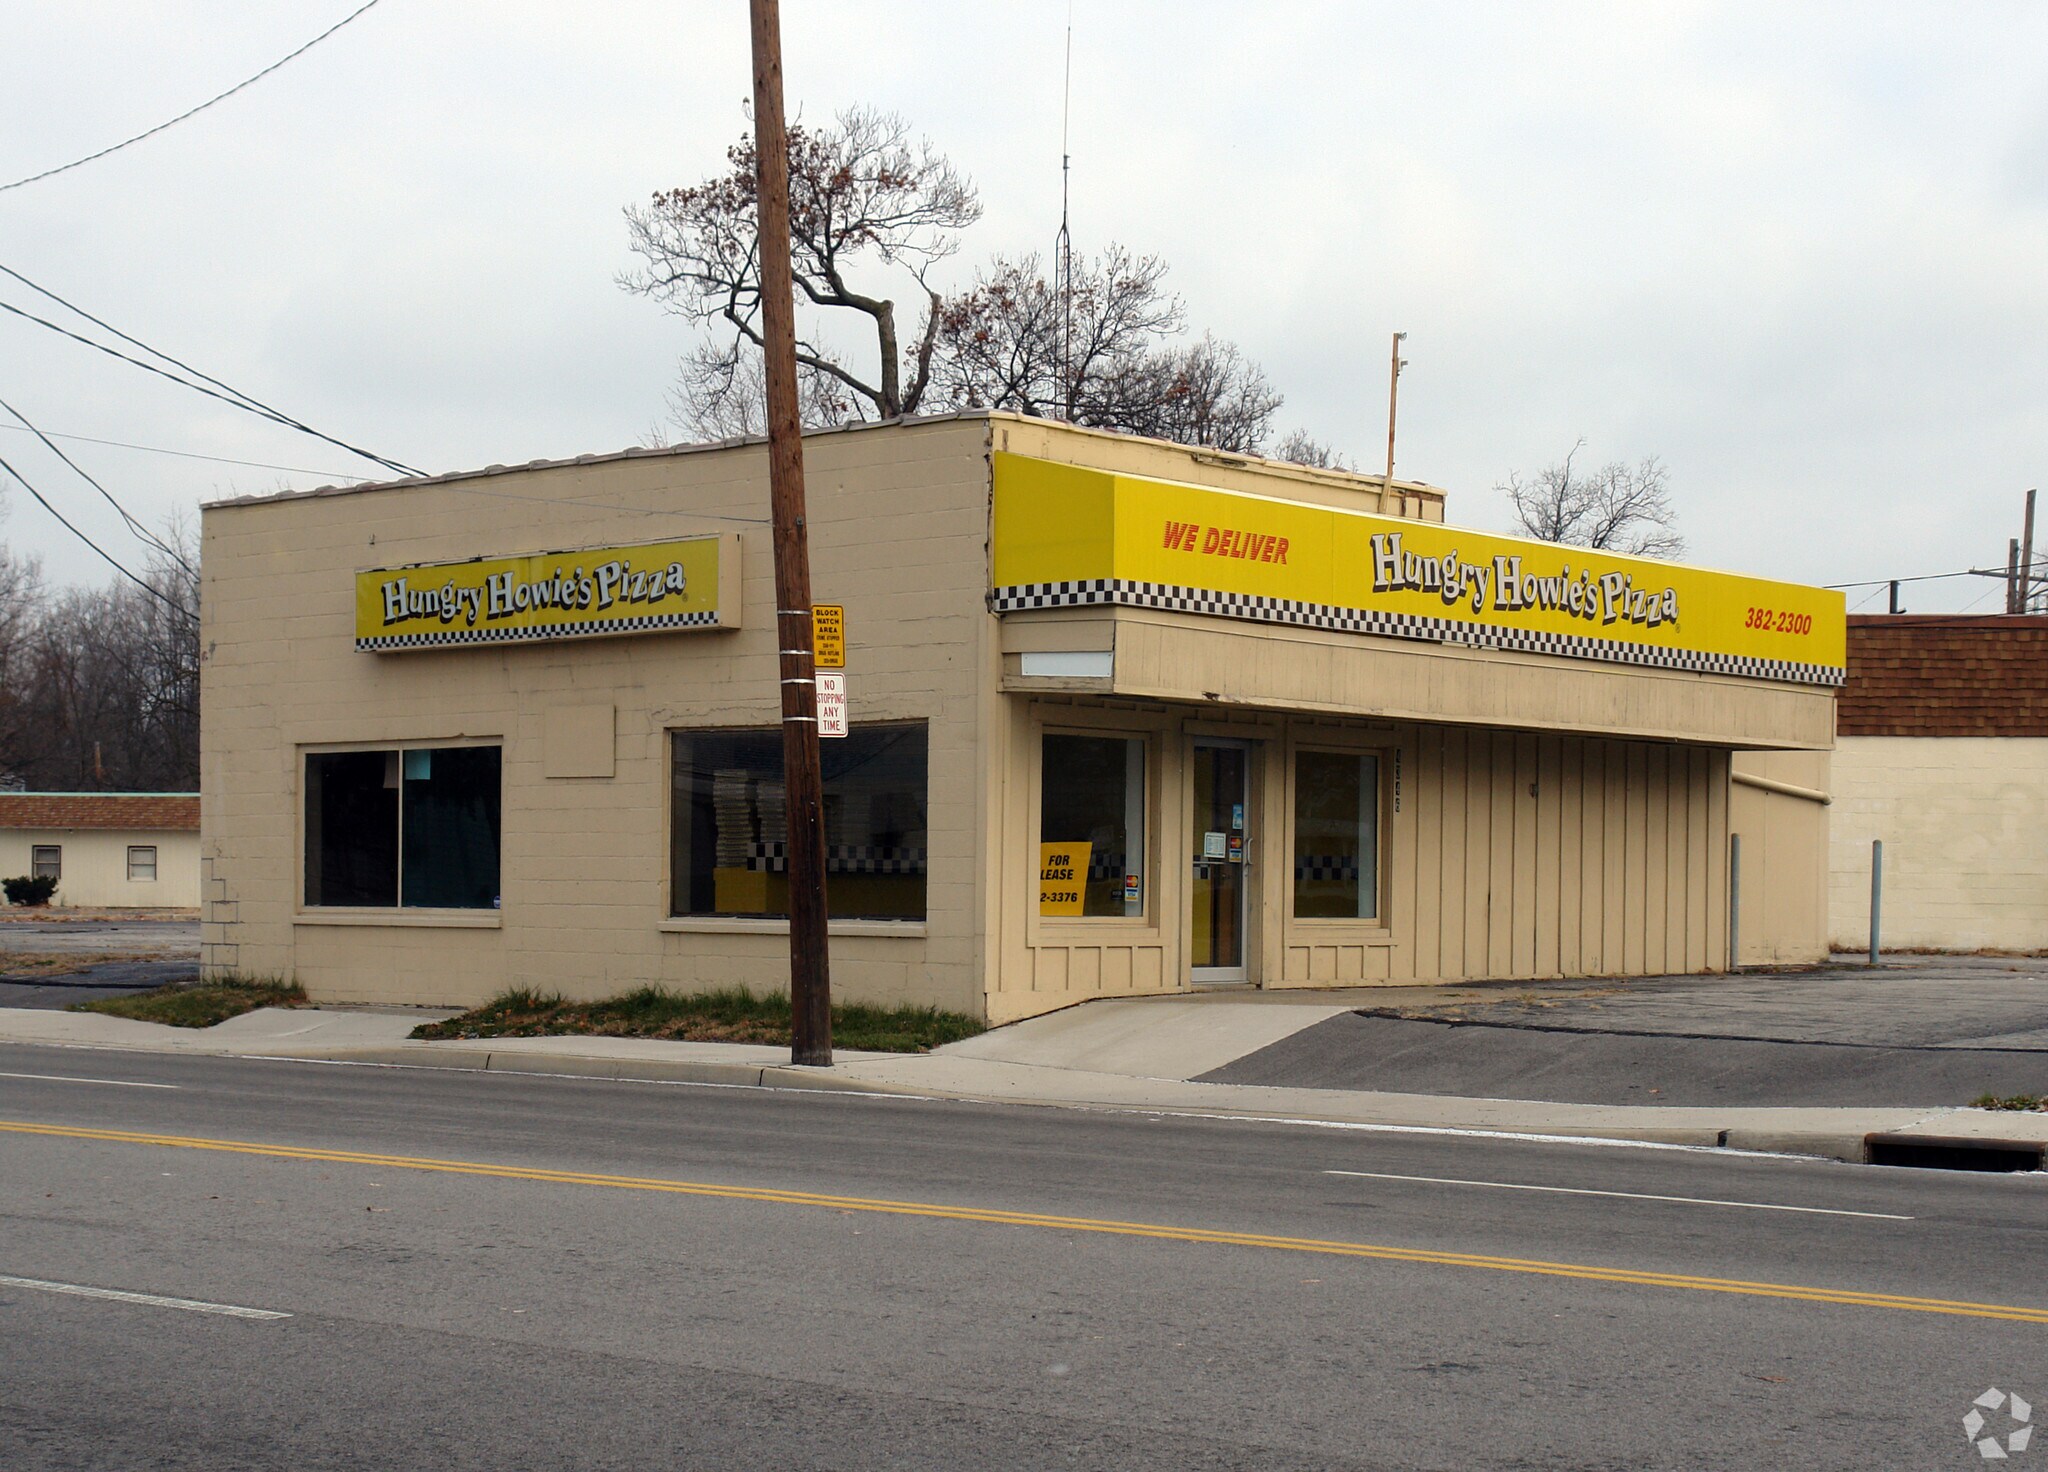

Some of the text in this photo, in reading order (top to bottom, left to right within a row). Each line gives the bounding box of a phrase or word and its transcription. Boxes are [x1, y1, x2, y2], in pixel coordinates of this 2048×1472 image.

[1162, 521, 1289, 565] WE DELIVER
[1370, 532, 1680, 630] Hungry Howie's Pizza
[381, 560, 686, 626] Hungry Howie's Pizza
[1745, 607, 1812, 635] 382-2300
[824, 679, 835, 690] NO
[816, 693, 844, 704] STOPPING
[823, 706, 839, 717] ANY
[823, 719, 840, 731] TIME
[1048, 855, 1070, 866] FOR
[1040, 869, 1074, 880] LEASE
